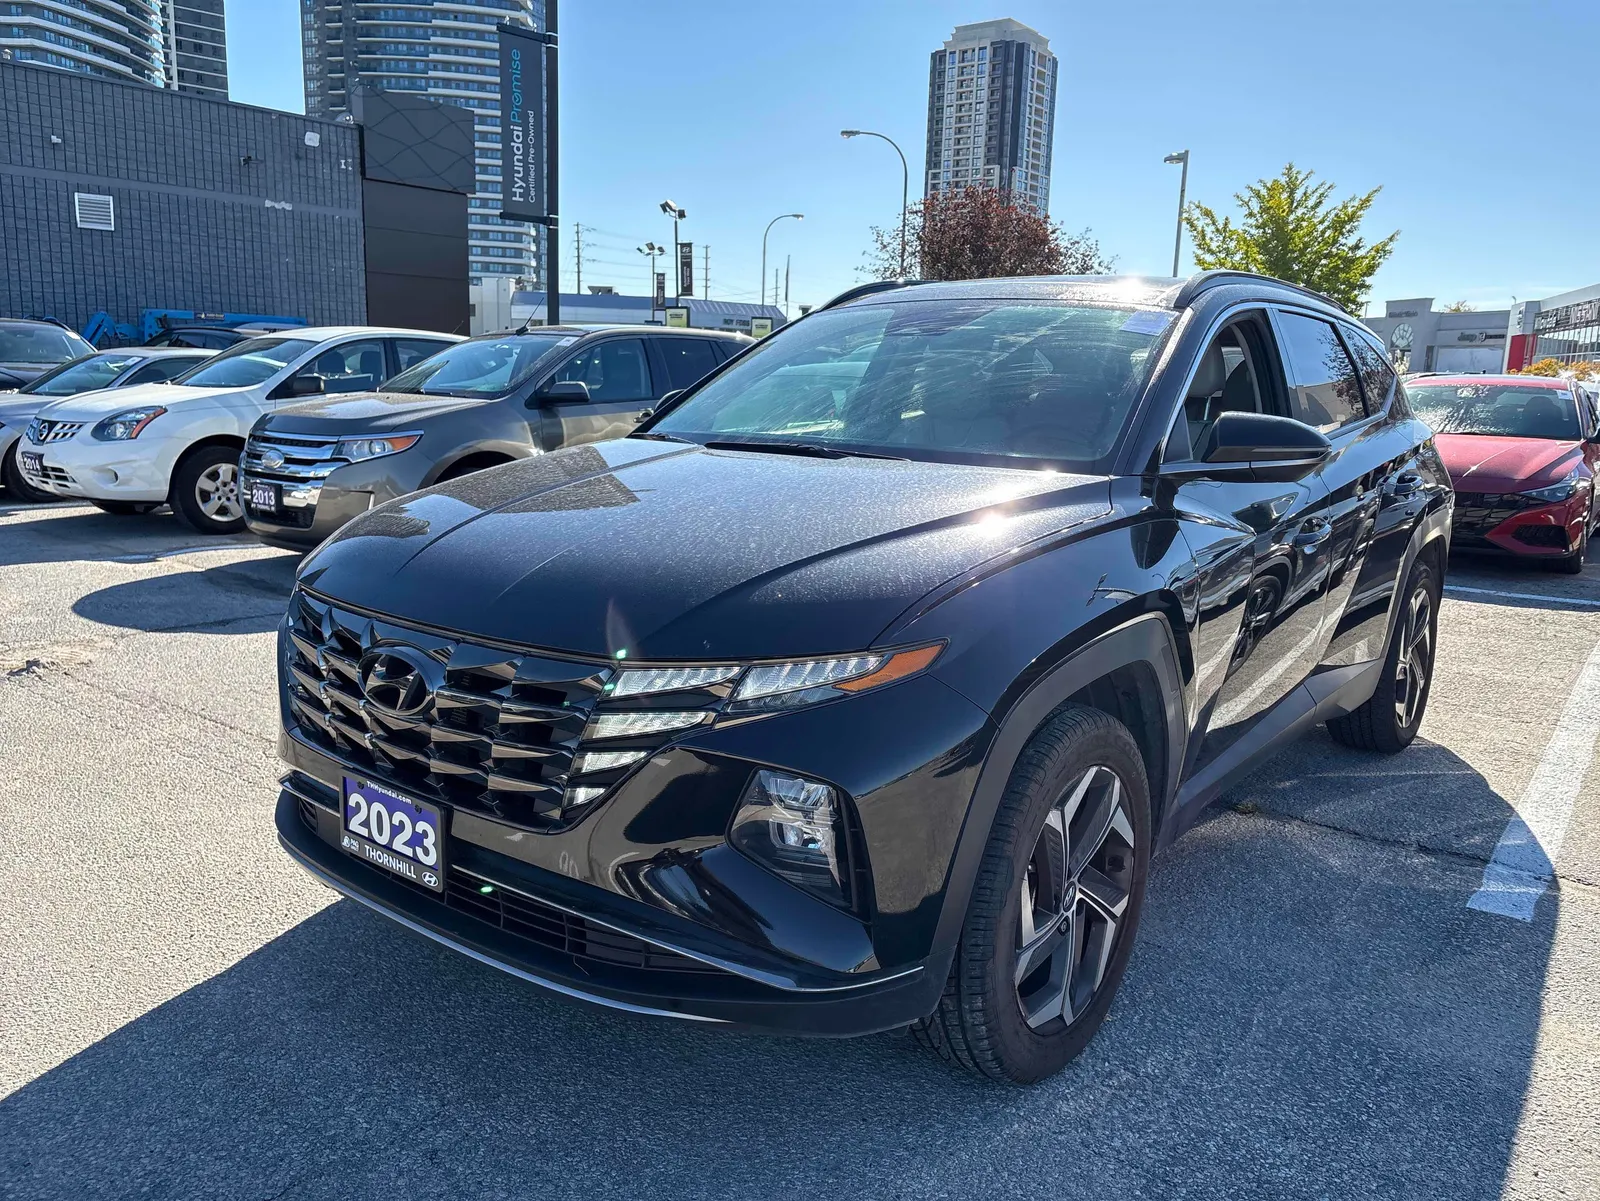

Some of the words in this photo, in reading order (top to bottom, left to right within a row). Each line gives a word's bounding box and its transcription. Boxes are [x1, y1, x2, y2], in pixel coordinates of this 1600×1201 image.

[510, 49, 523, 123] Promise
[527, 110, 535, 163] Pre-Owned
[511, 125, 525, 202] Hyundai
[528, 164, 536, 203] Certified
[24, 457, 40, 471] 2014
[252, 489, 275, 506] 2013
[348, 792, 437, 867] 2023
[364, 844, 417, 879] THORNHILL
